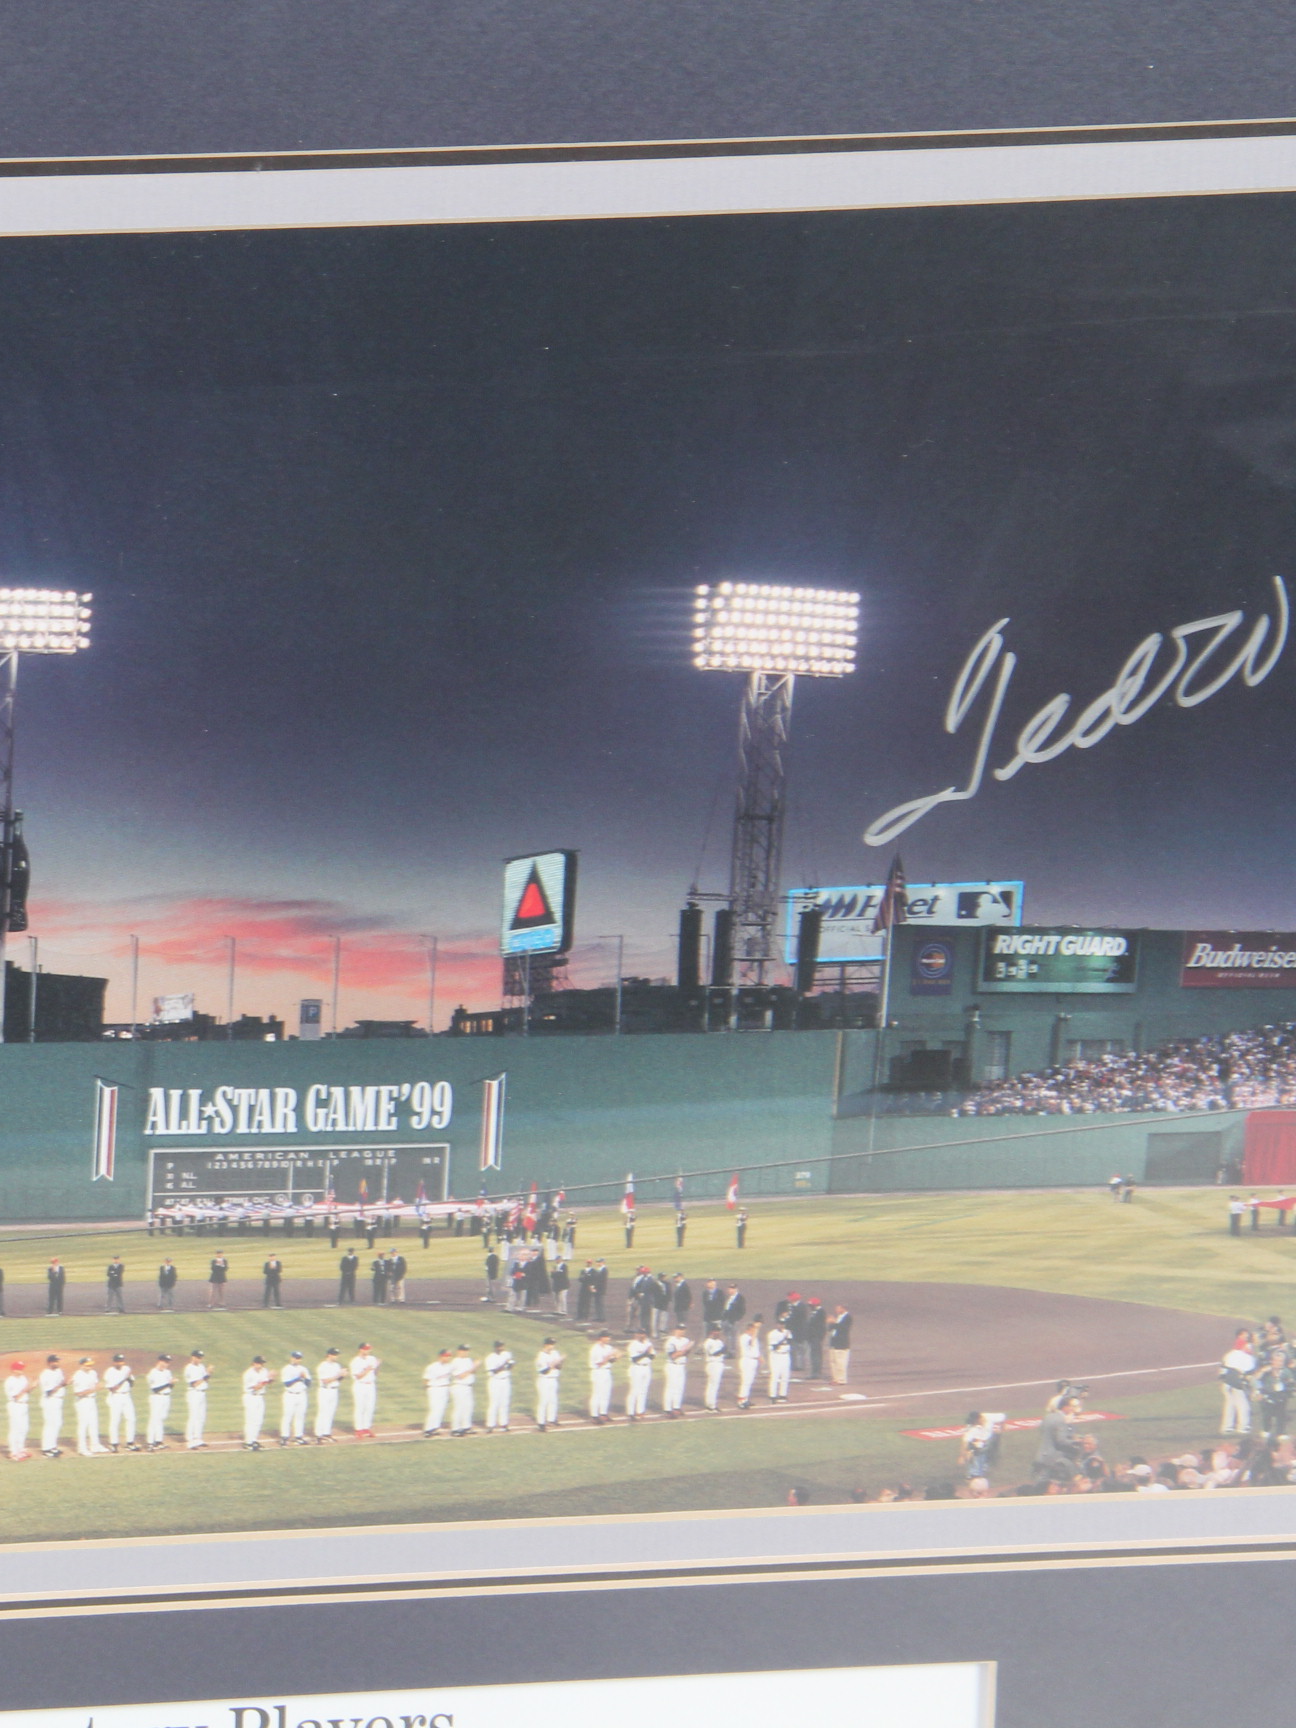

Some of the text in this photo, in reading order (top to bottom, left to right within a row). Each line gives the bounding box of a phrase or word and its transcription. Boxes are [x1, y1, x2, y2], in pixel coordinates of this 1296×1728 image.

[994, 935, 1127, 957] RIGHT GUARD
[1185, 942, 1296, 968] Budweise
[306, 1083, 400, 1133] GAME
[215, 1150, 397, 1160] AMERICAN LEAGUE
